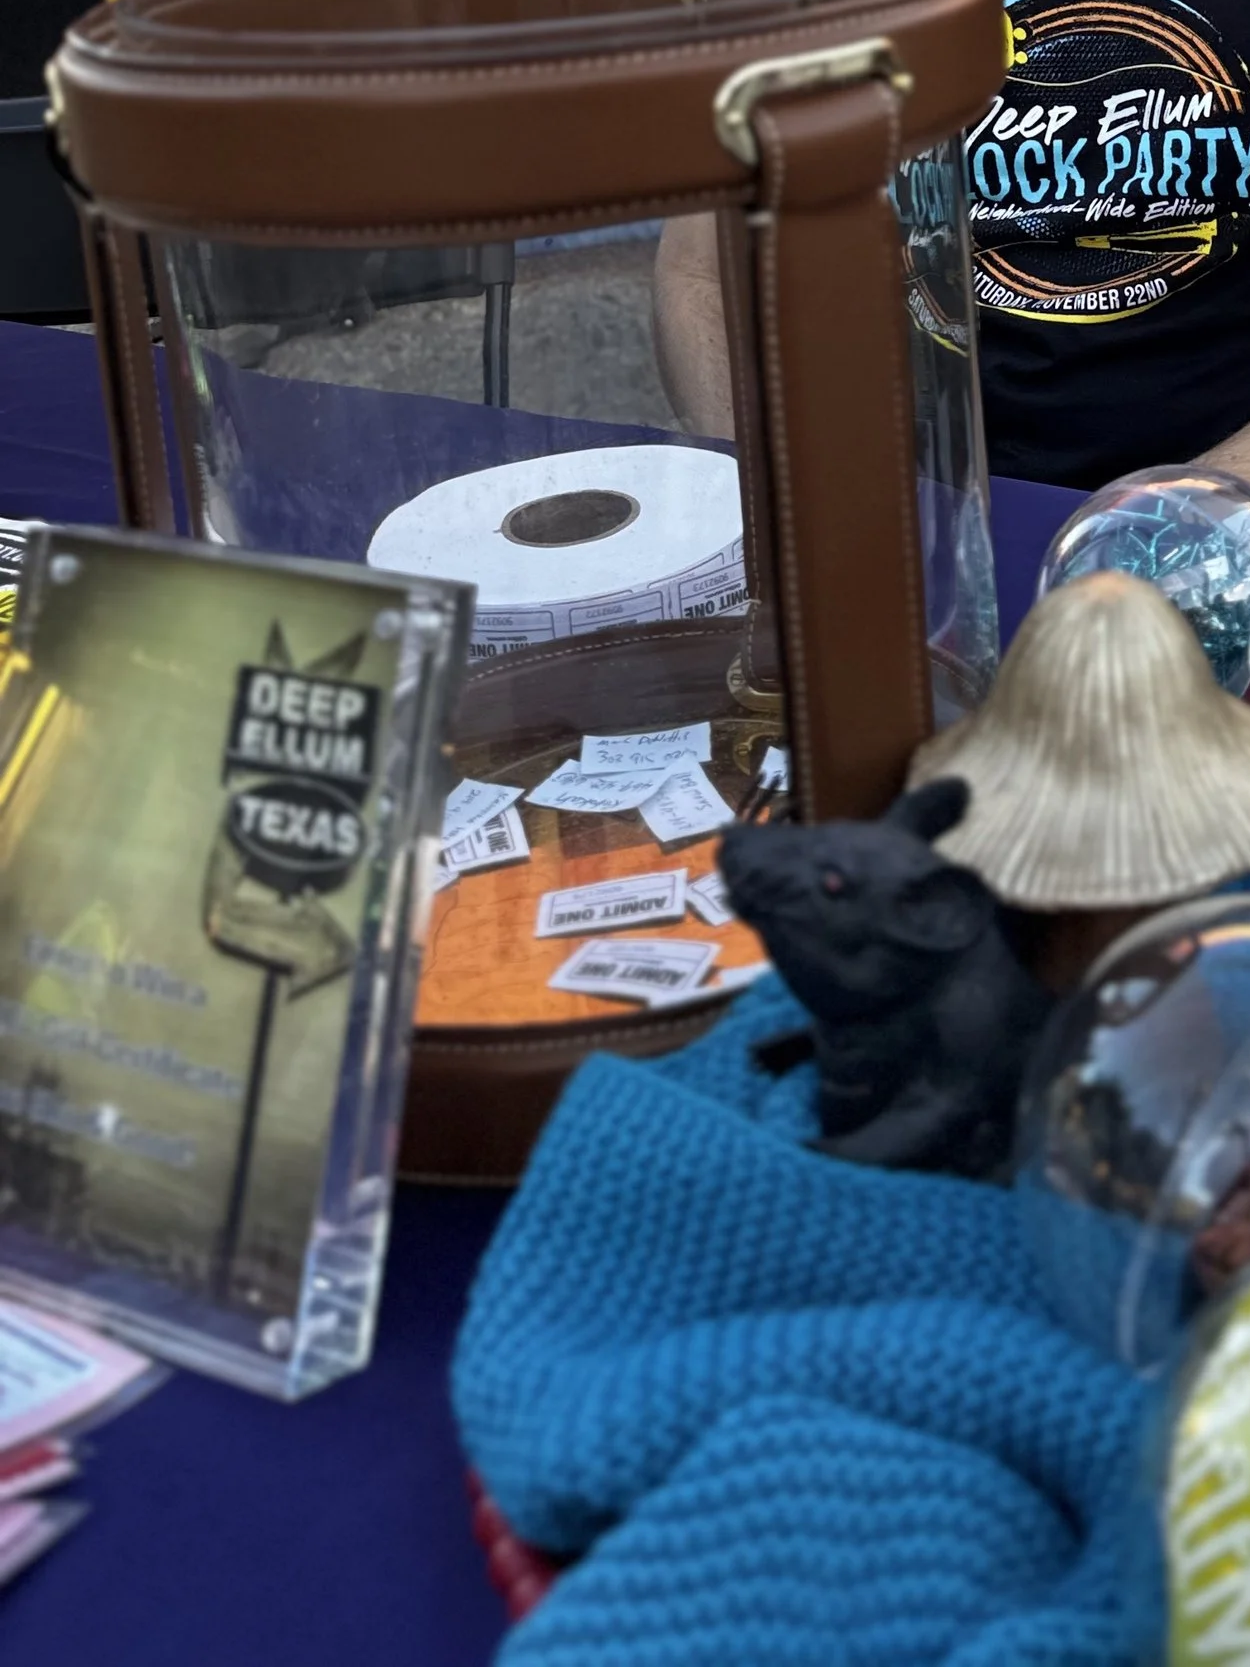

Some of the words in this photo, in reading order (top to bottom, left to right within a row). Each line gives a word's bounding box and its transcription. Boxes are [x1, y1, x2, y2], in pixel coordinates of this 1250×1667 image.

[1097, 88, 1213, 145] Ellum
[965, 137, 1088, 204] OCK
[1143, 201, 1215, 222] Edition
[1124, 277, 1168, 305] 22ND
[684, 599, 715, 619] ONE
[249, 672, 366, 730] DEEP
[239, 718, 365, 775] ELLUM
[237, 795, 359, 856] TEXAS
[553, 908, 596, 926] ONE
[600, 895, 669, 919] ADMIT
[574, 961, 619, 977] ONE
[617, 964, 688, 988] ADMIT
